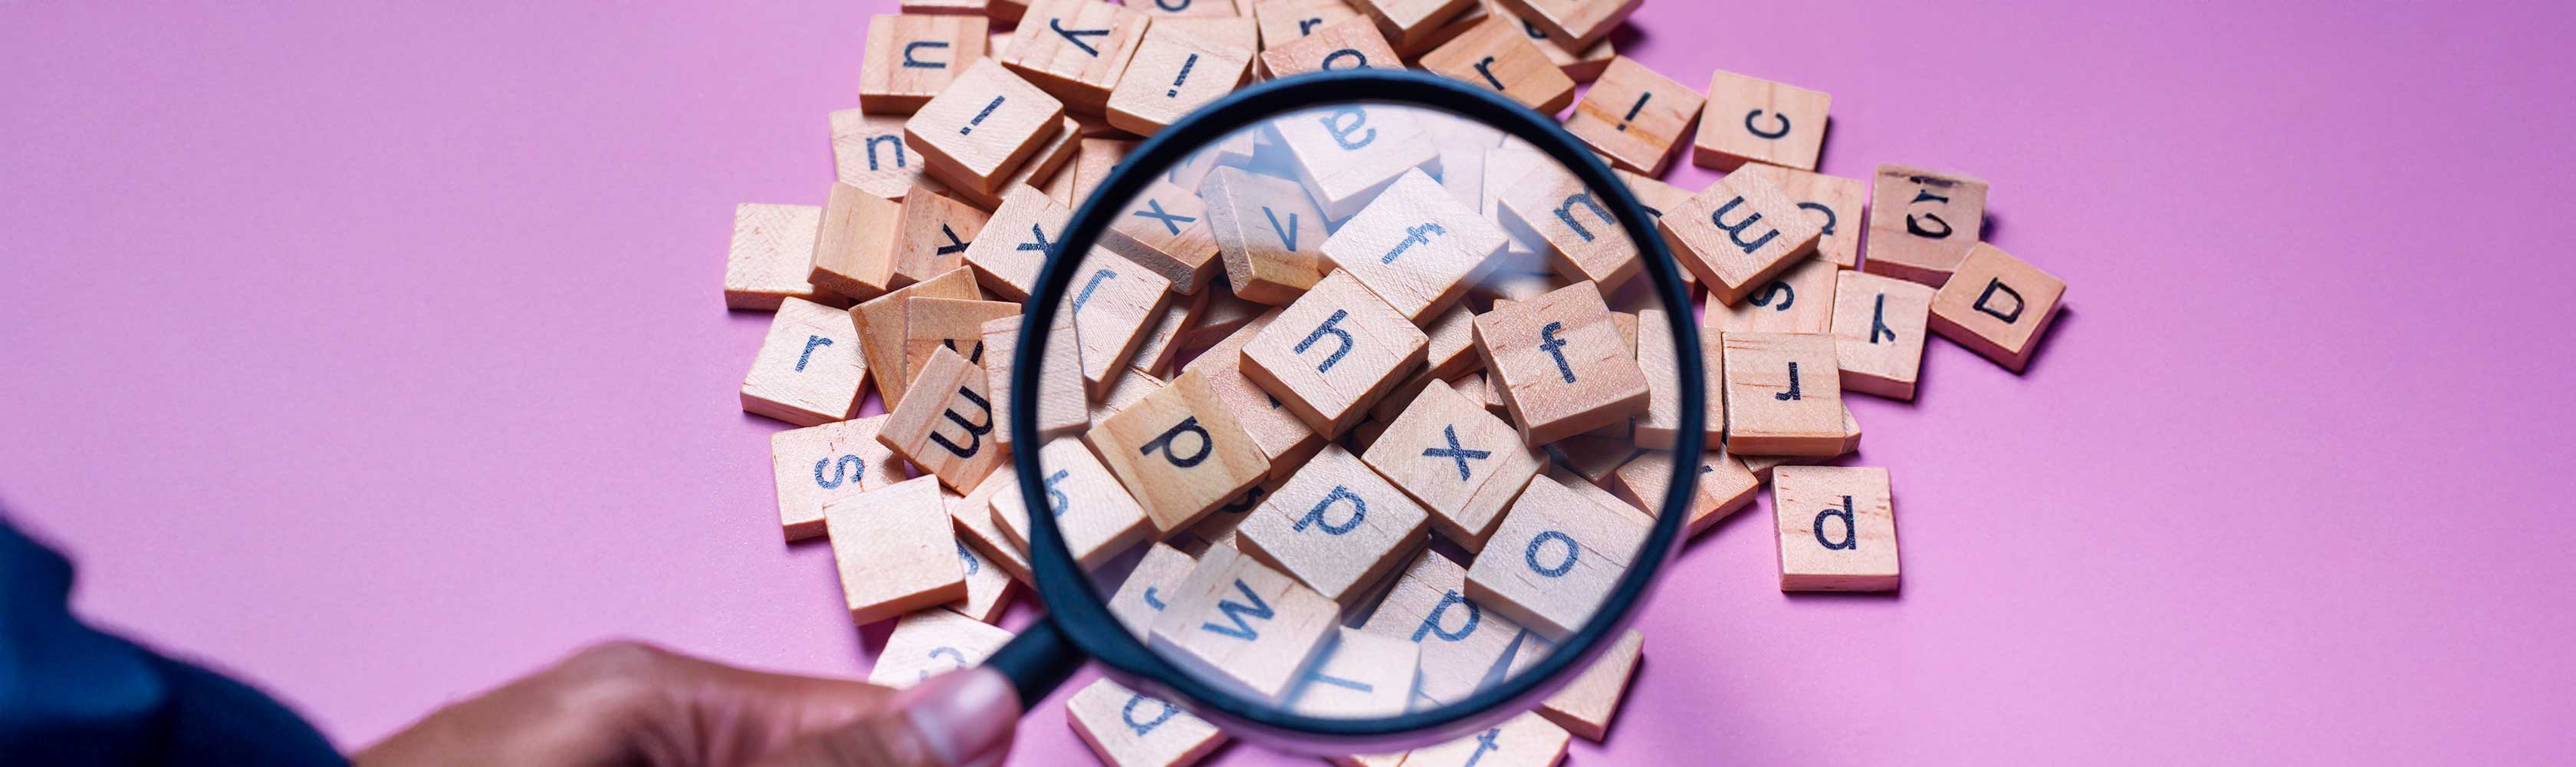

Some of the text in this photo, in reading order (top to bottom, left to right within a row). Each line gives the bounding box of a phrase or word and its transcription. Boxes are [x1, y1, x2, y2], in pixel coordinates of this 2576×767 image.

[795, 334, 834, 373] r
[1539, 321, 1577, 384] f
[1421, 423, 1492, 482] x
[1525, 530, 1579, 578] o
